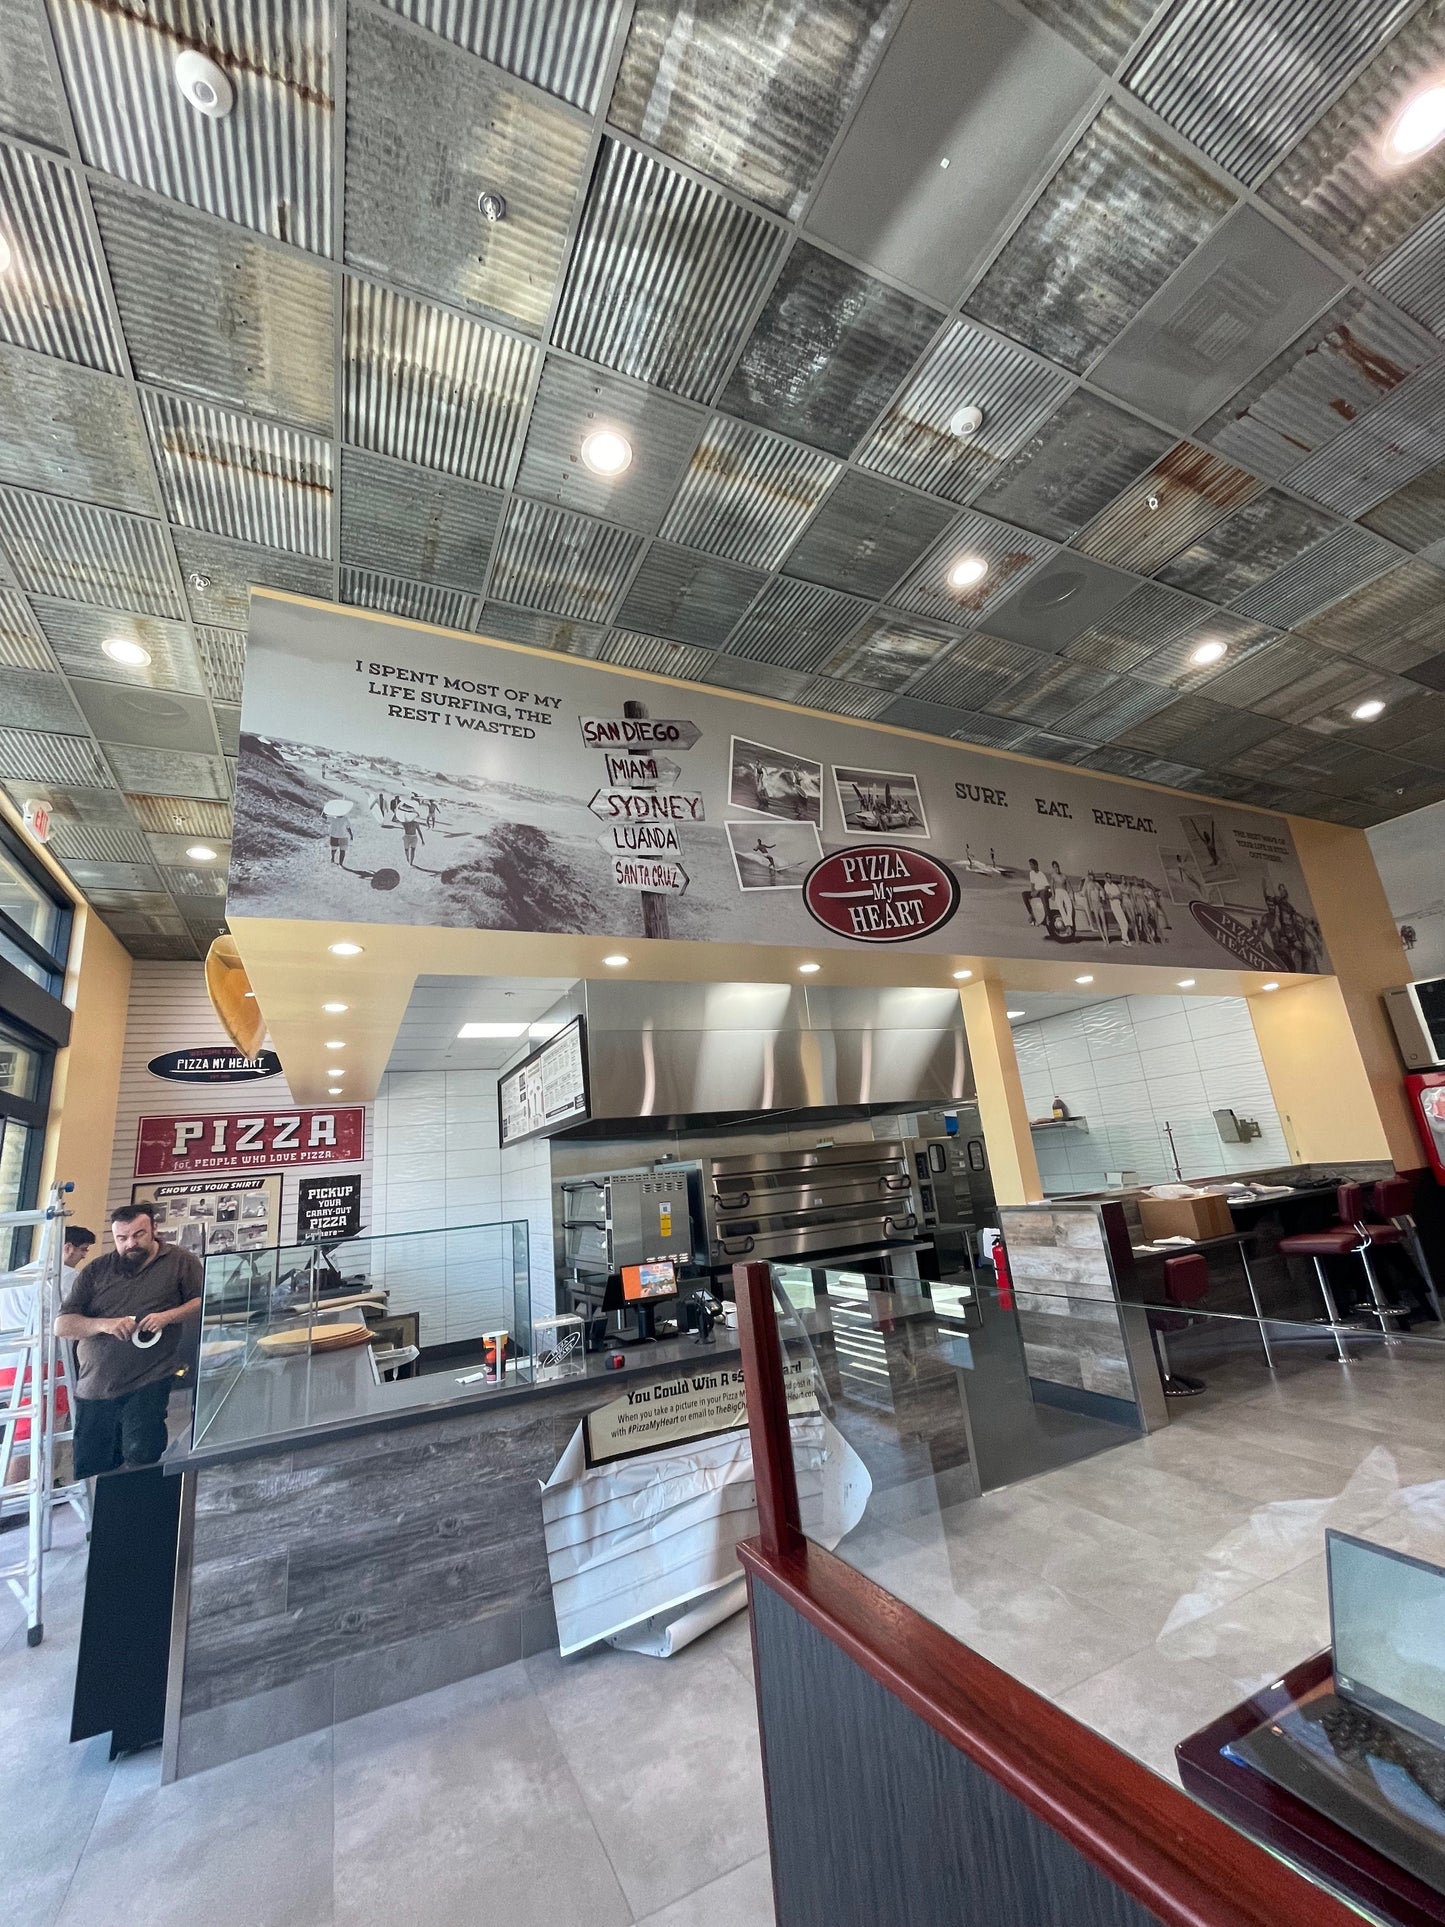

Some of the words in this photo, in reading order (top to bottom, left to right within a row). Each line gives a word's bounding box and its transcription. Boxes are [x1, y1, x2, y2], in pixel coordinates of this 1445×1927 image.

[356, 659, 363, 673] I
[369, 662, 438, 686] SPENT
[443, 676, 499, 697] MOST
[504, 688, 529, 703] OF
[534, 693, 562, 709] MY
[368, 681, 415, 701] LIFE
[420, 690, 511, 720] SURFING,
[515, 707, 552, 725] THE
[388, 703, 440, 724] REST
[445, 713, 452, 726] I
[455, 715, 536, 740] WASTED
[584, 721, 620, 742] SAN
[622, 721, 680, 742] DIEGO
[611, 758, 659, 781] MIAMI
[607, 794, 699, 819] SYDNEY
[955, 782, 1008, 807] SURF.
[1034, 798, 1073, 820] EAT.
[1091, 808, 1158, 834] REPEAT.
[613, 827, 678, 850] LUANDA
[615, 861, 650, 885] SANTA
[652, 865, 680, 888] CRUZ
[840, 853, 911, 883] PIZZA
[871, 882, 893, 903] My
[848, 899, 926, 934] HEART
[1220, 914, 1265, 953] PIZZA
[1216, 929, 1266, 971] HEART
[177, 1058, 209, 1070] PIZZA
[212, 1058, 226, 1070] MY
[229, 1057, 265, 1069] HEART
[172, 1114, 338, 1156] PIZZA
[194, 1159, 238, 1168] PEOPLE
[241, 1156, 266, 1165] WHO
[270, 1153, 297, 1162] LOVE
[300, 1150, 335, 1161] PIZZA.
[160, 1186, 187, 1195] SHOW
[190, 1184, 202, 1192] US
[205, 1182, 230, 1191] YOUR
[230, 1180, 261, 1189] SHIRT!
[308, 1186, 353, 1200] PICKUP
[306, 1206, 352, 1218] CARRY-OUT
[318, 1198, 342, 1208] YOUR
[310, 1215, 347, 1230] PIZZA
[627, 1391, 651, 1406] You
[654, 1380, 689, 1400] Could
[691, 1376, 718, 1391] Win
[721, 1373, 730, 1387] A
[783, 1361, 802, 1375] ard
[617, 1412, 639, 1424] When
[640, 1410, 653, 1421] you
[654, 1405, 668, 1416] take
[670, 1405, 674, 1413] a
[675, 1399, 698, 1414] picture
[699, 1397, 706, 1406] in
[707, 1395, 721, 1408] your
[722, 1391, 738, 1402] Pizza
[740, 1389, 746, 1398] M
[611, 1426, 627, 1438] with
[628, 1415, 679, 1435] #PizzaMyHeart
[680, 1414, 687, 1423] or
[688, 1407, 707, 1421] email
[708, 1407, 714, 1417] to
